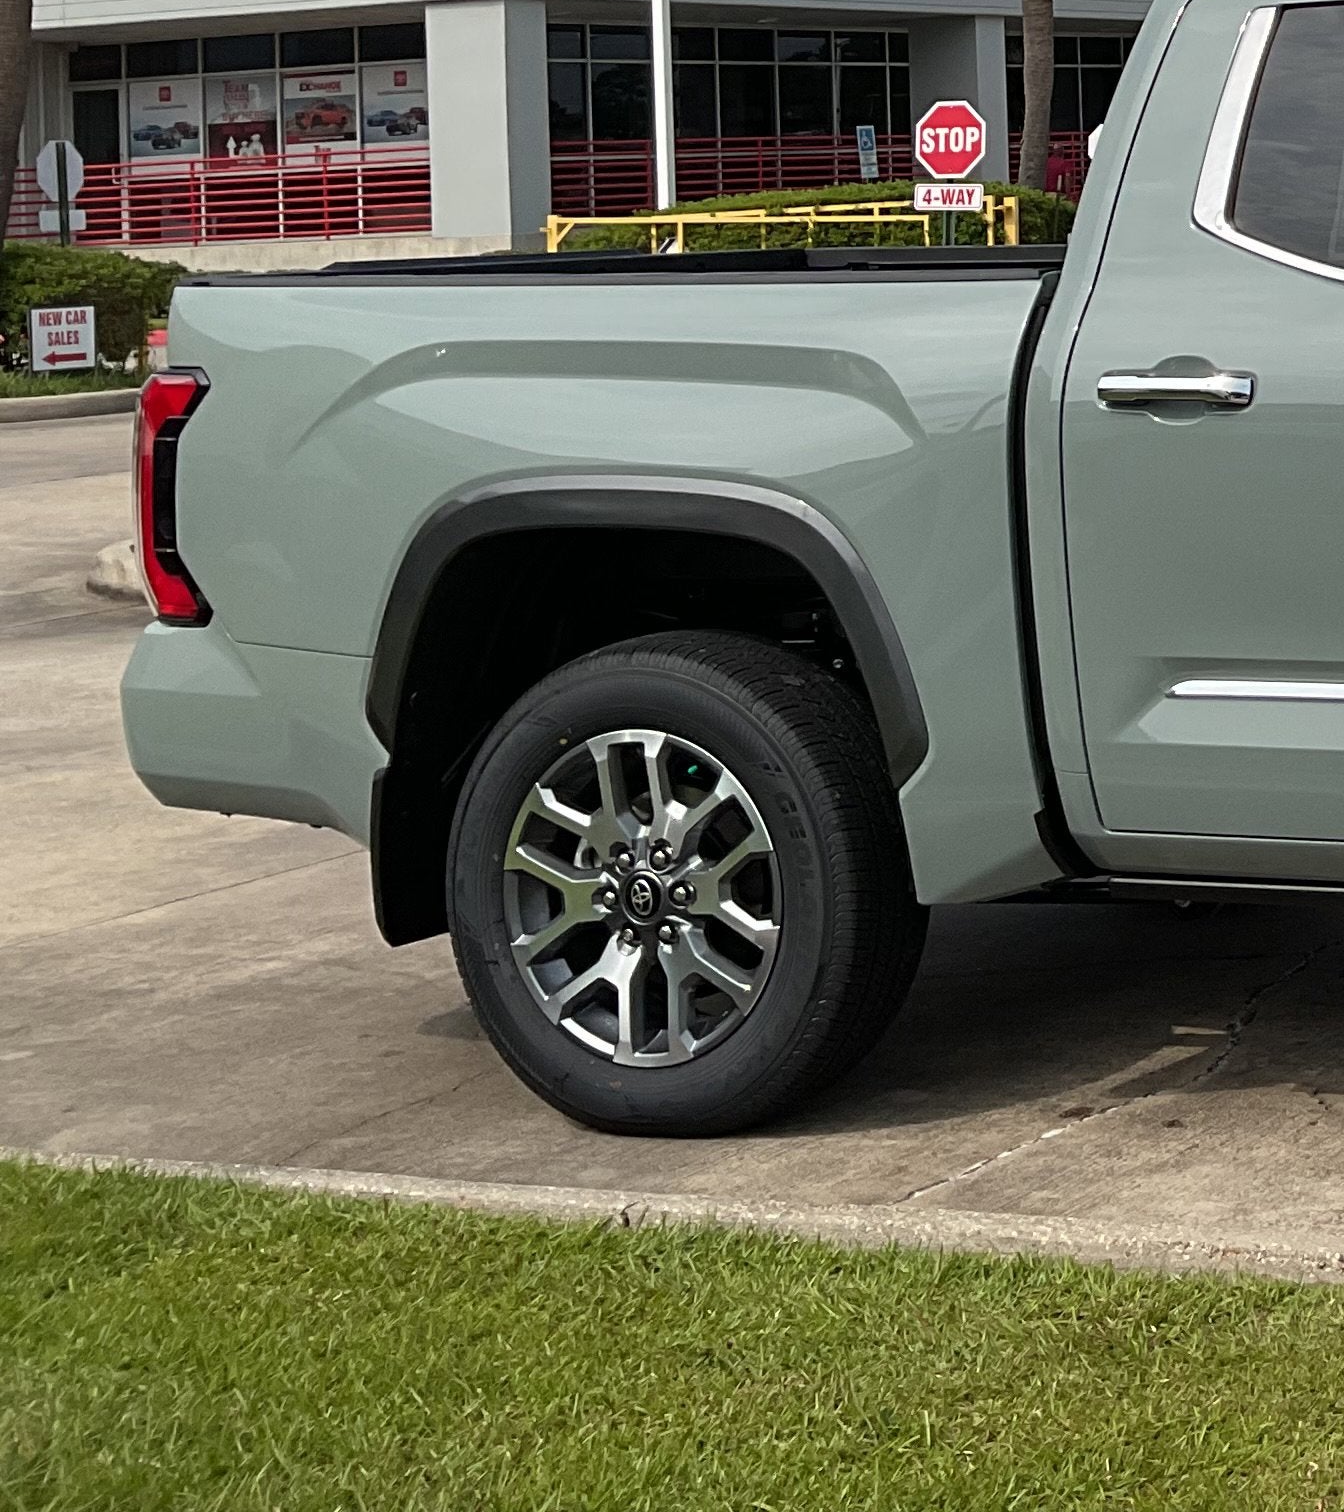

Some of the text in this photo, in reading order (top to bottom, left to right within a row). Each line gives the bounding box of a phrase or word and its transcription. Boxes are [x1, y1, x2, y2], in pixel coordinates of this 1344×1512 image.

[921, 126, 980, 154] STOP
[922, 188, 976, 206] 4-WAY
[38, 309, 87, 327] NEW CAR
[47, 330, 80, 347] SALES
